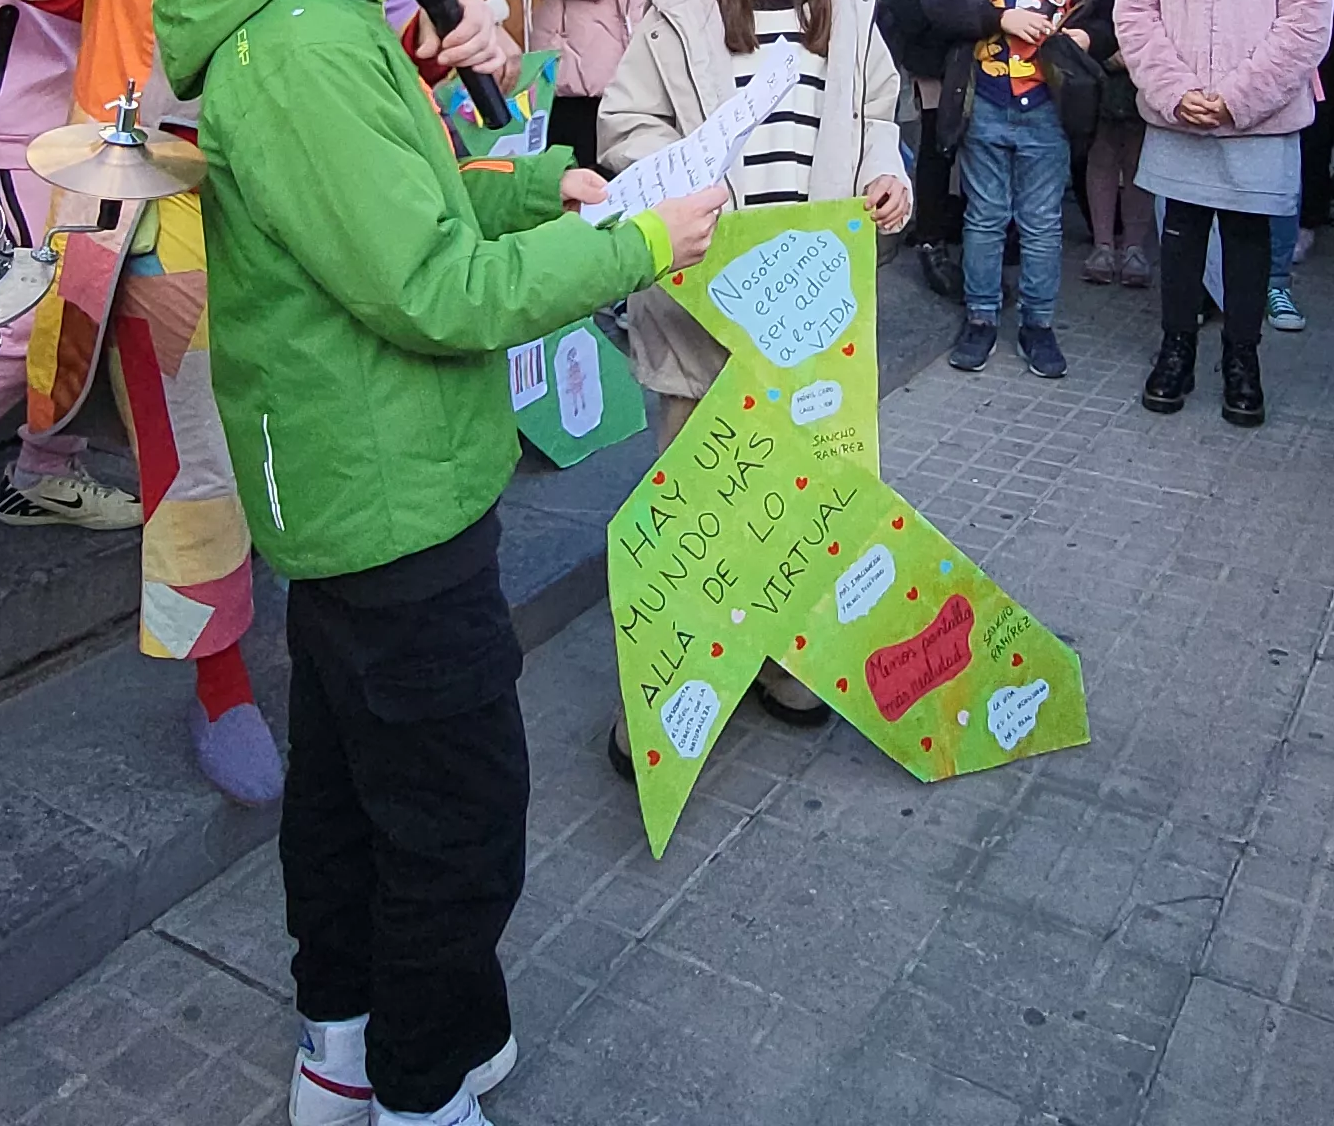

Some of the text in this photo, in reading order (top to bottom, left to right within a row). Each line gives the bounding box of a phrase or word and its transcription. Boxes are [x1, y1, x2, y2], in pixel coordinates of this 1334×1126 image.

[710, 233, 798, 316] Nosotros
[754, 235, 828, 316] elegimos
[758, 251, 848, 351] ser adictos
[779, 320, 817, 362] a la
[808, 297, 855, 350] VIDA
[811, 426, 857, 448] SANCHO
[619, 415, 737, 569] HAY UN
[619, 431, 775, 645] MUNDO MÁS
[750, 487, 858, 614] VIRTUAL
[640, 490, 786, 710] ALLÁ DE LO
